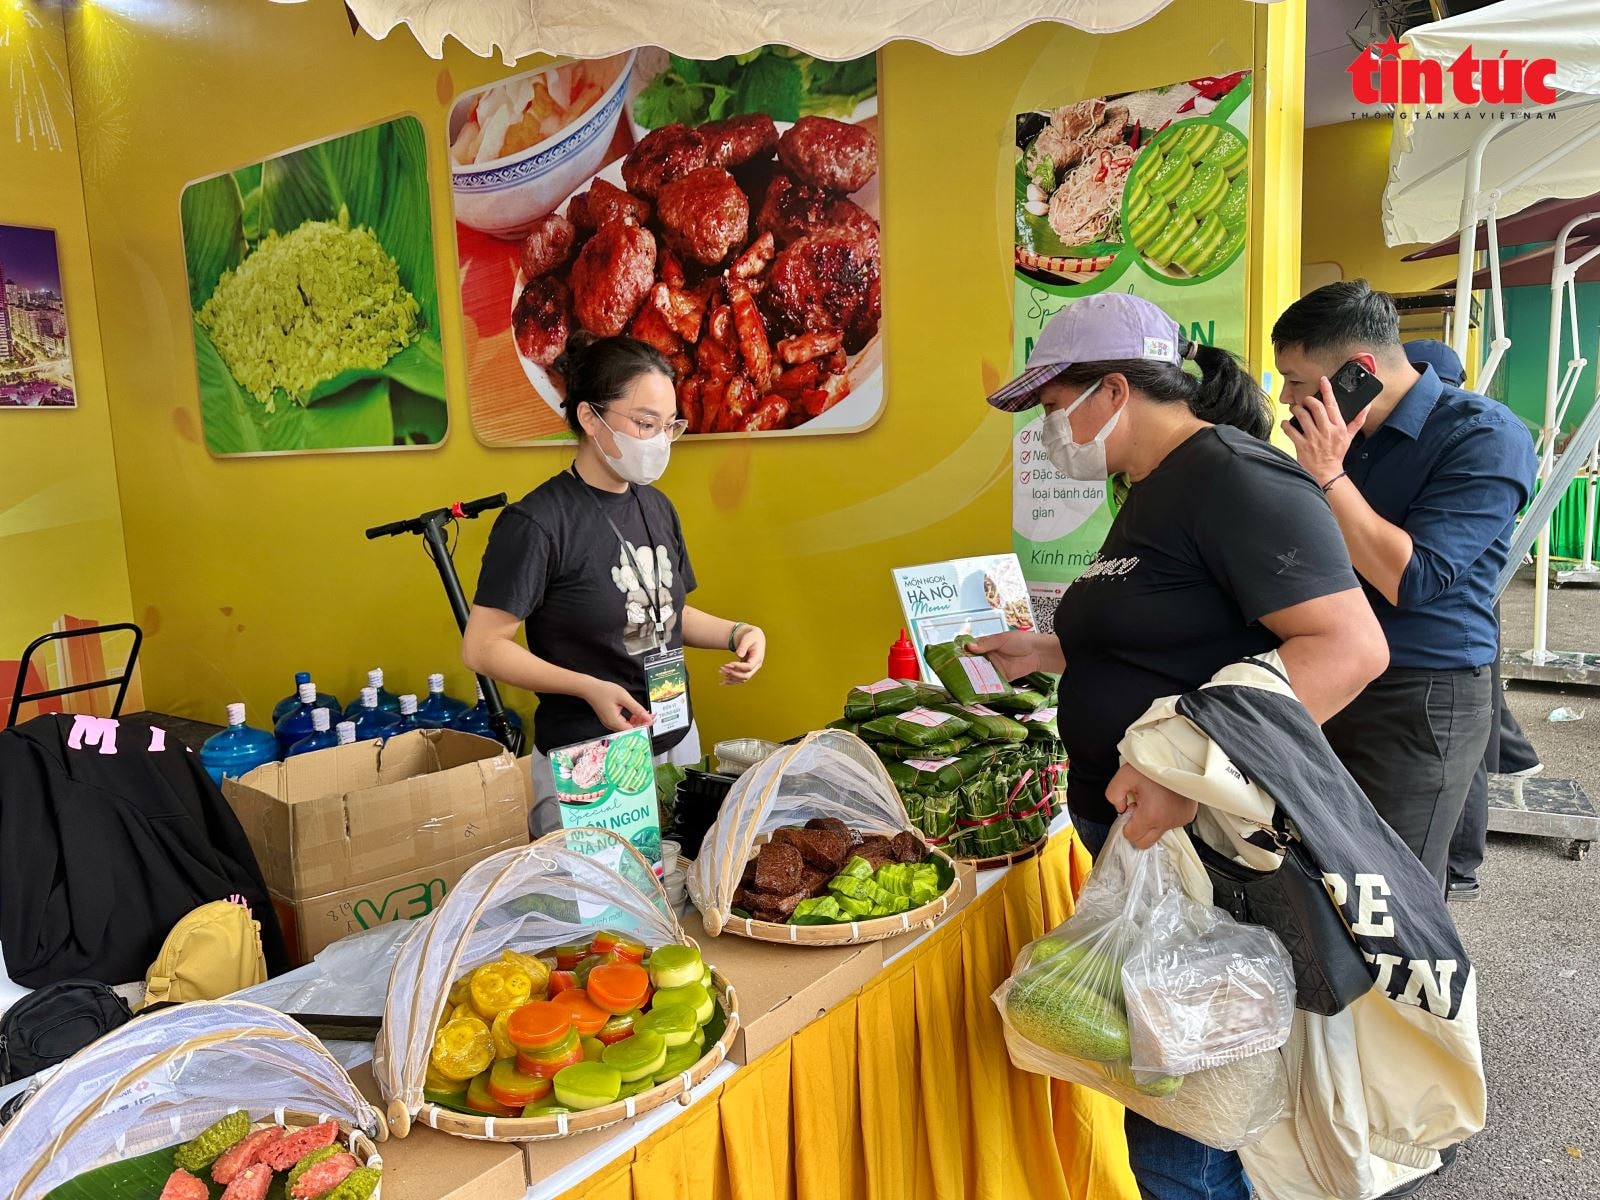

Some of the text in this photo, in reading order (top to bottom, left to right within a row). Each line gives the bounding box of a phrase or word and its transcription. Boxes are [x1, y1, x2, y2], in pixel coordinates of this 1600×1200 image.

[1032, 487, 1051, 501] loại
[1053, 487, 1080, 499] bánh
[1032, 507, 1055, 520] gian
[1030, 549, 1064, 566] Kính
[924, 574, 946, 585] NGON
[931, 582, 958, 602] NỘI
[609, 805, 650, 830] NGON
